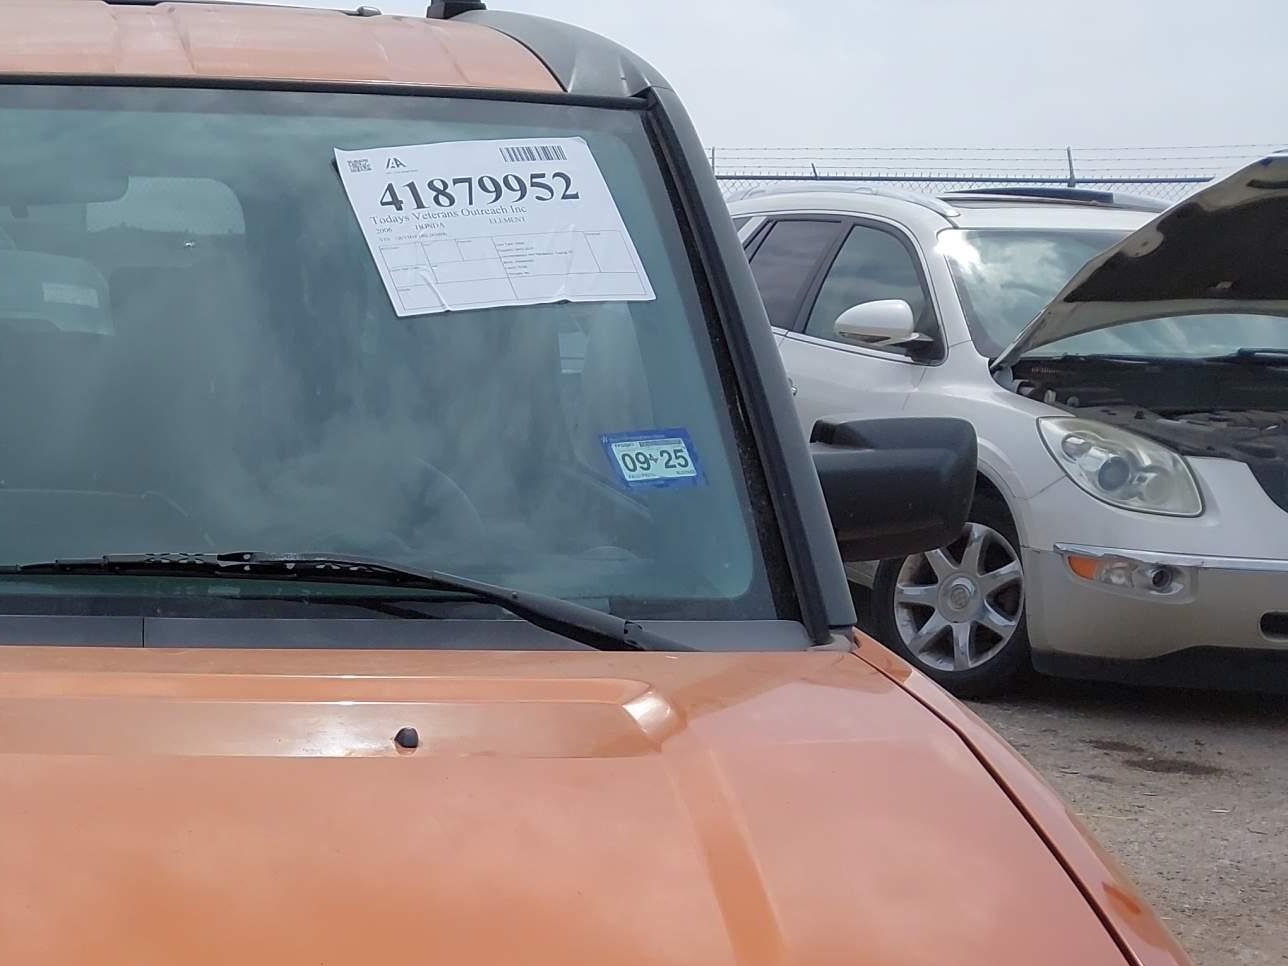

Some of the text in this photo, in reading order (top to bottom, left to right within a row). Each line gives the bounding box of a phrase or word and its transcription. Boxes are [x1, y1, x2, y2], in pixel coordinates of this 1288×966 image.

[380, 172, 580, 211] 41879952
[370, 204, 527, 226] Todays Veterans Outreach Inc
[621, 449, 689, 472] 09 25
